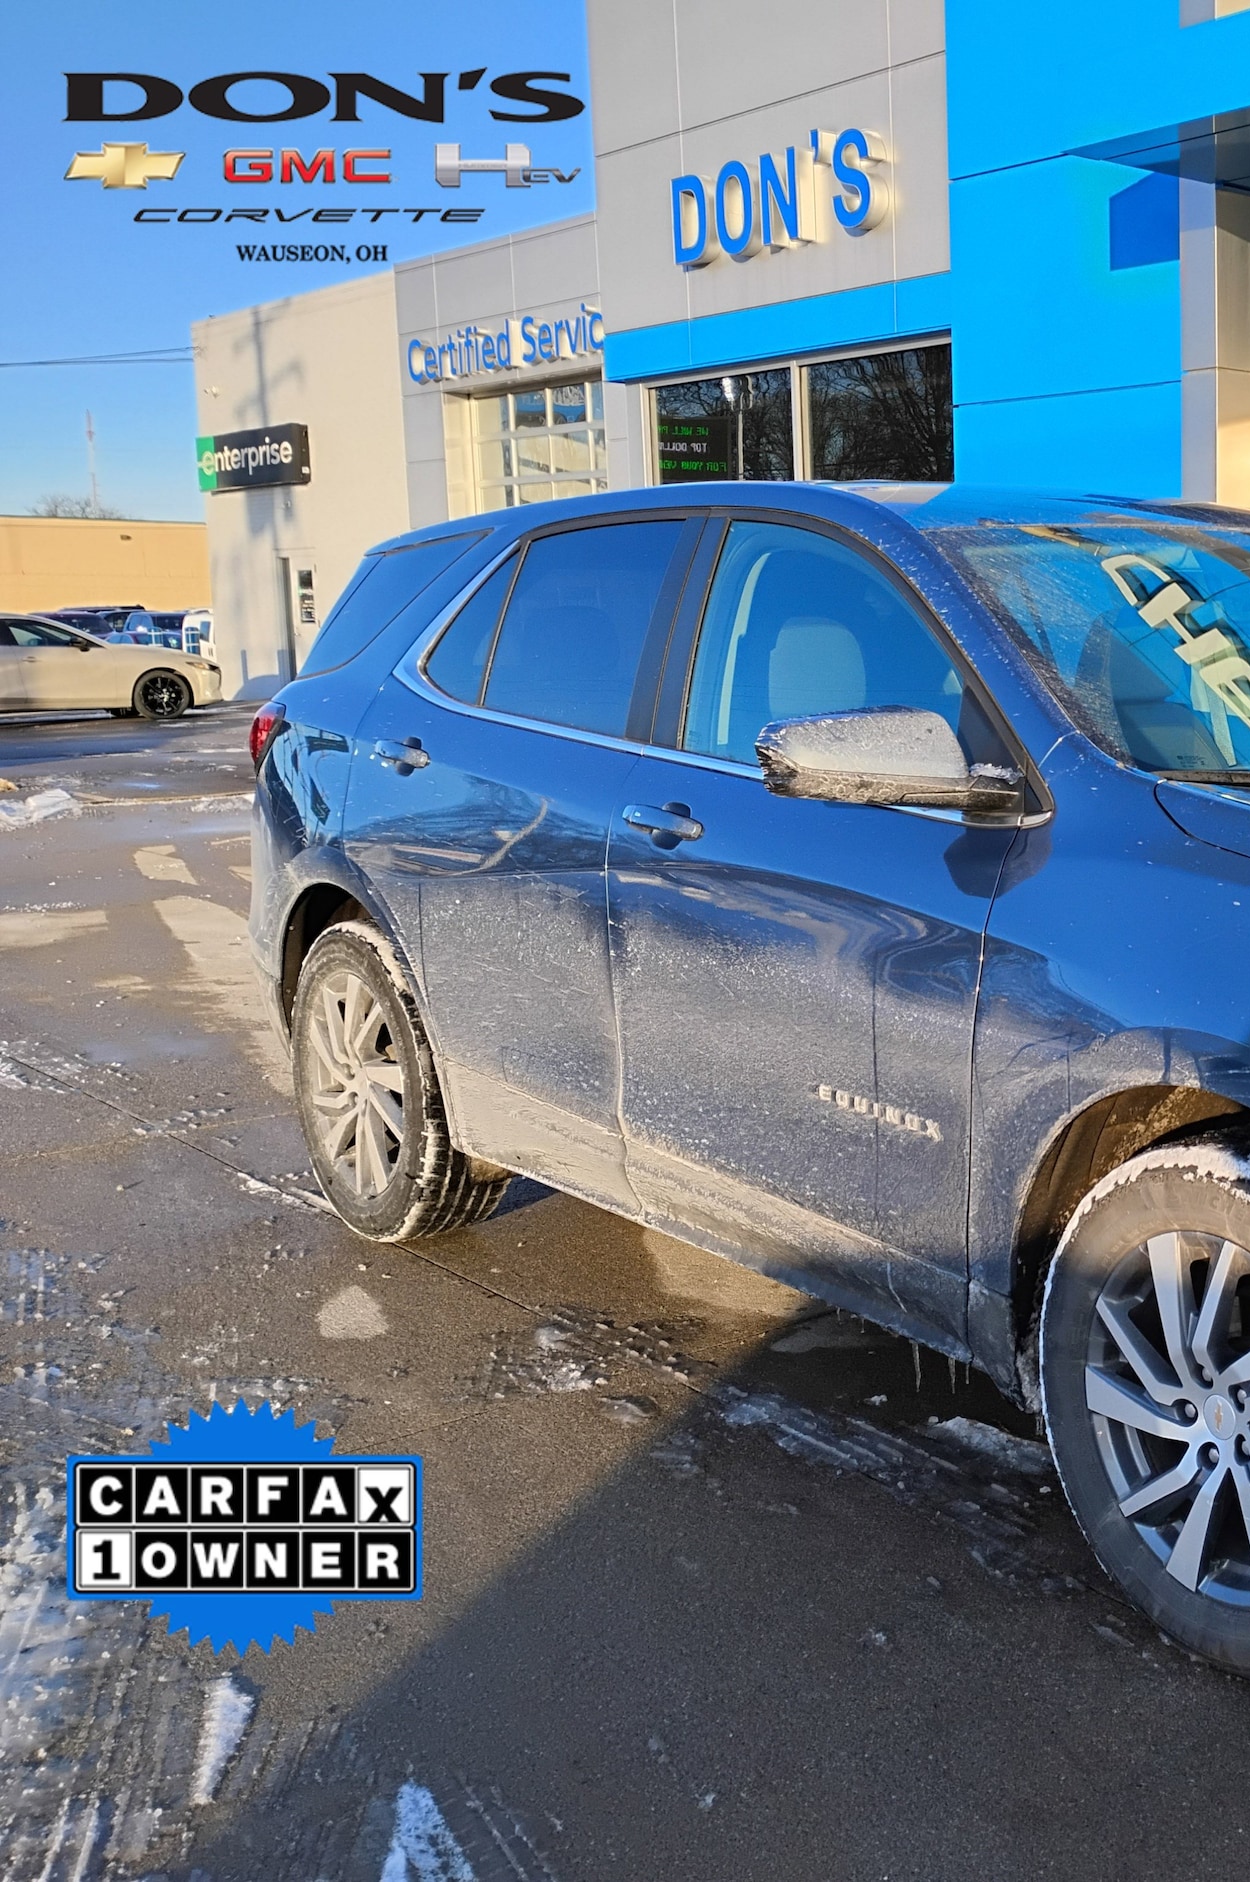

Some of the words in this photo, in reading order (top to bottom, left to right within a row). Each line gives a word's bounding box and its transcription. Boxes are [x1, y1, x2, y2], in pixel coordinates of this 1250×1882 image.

[670, 128, 872, 265] DON'S
[407, 318, 512, 383] Certified
[200, 436, 293, 476] enterprise
[817, 1084, 944, 1143] EQUINOX
